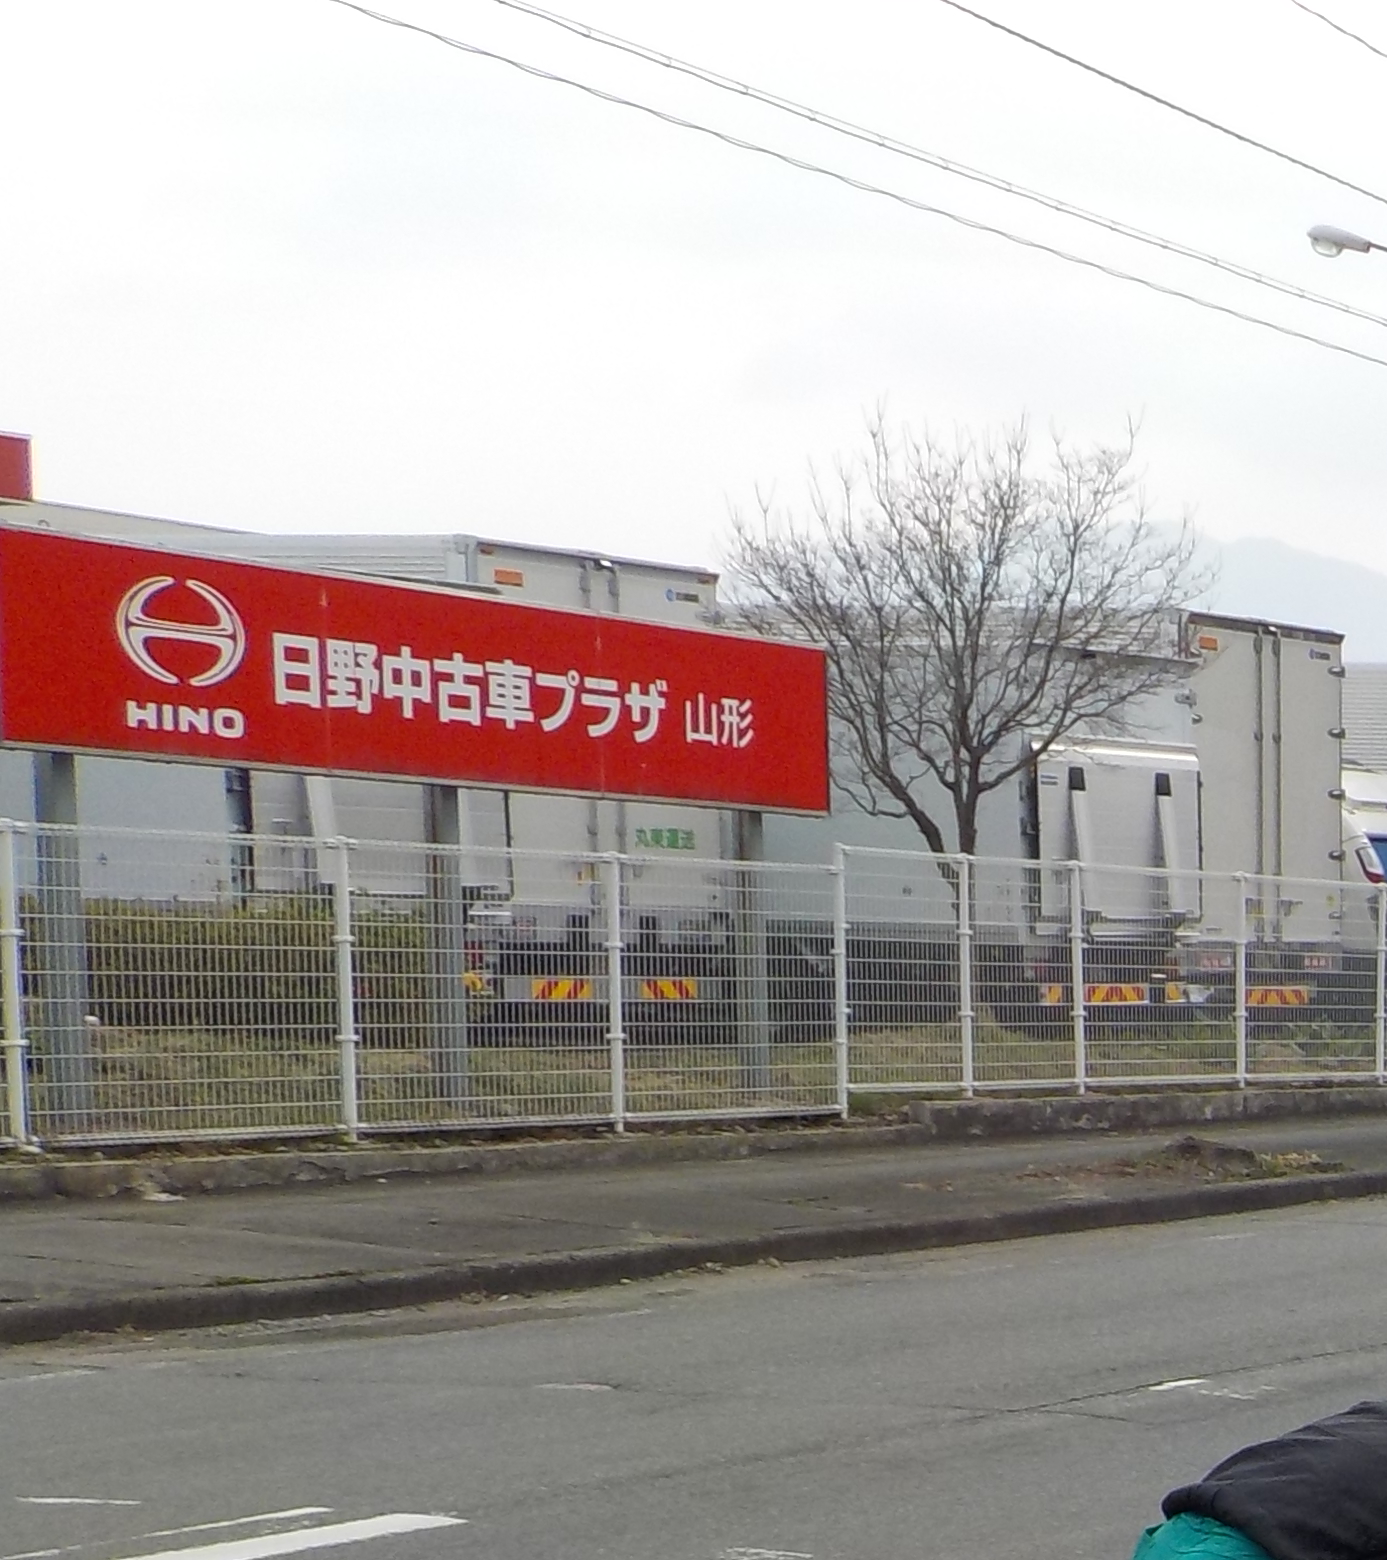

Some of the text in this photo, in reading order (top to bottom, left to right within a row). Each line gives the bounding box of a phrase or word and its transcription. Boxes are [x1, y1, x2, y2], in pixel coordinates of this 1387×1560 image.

[126, 700, 245, 738] HINO
[273, 632, 754, 748] 日野中古車プラザ 山形
